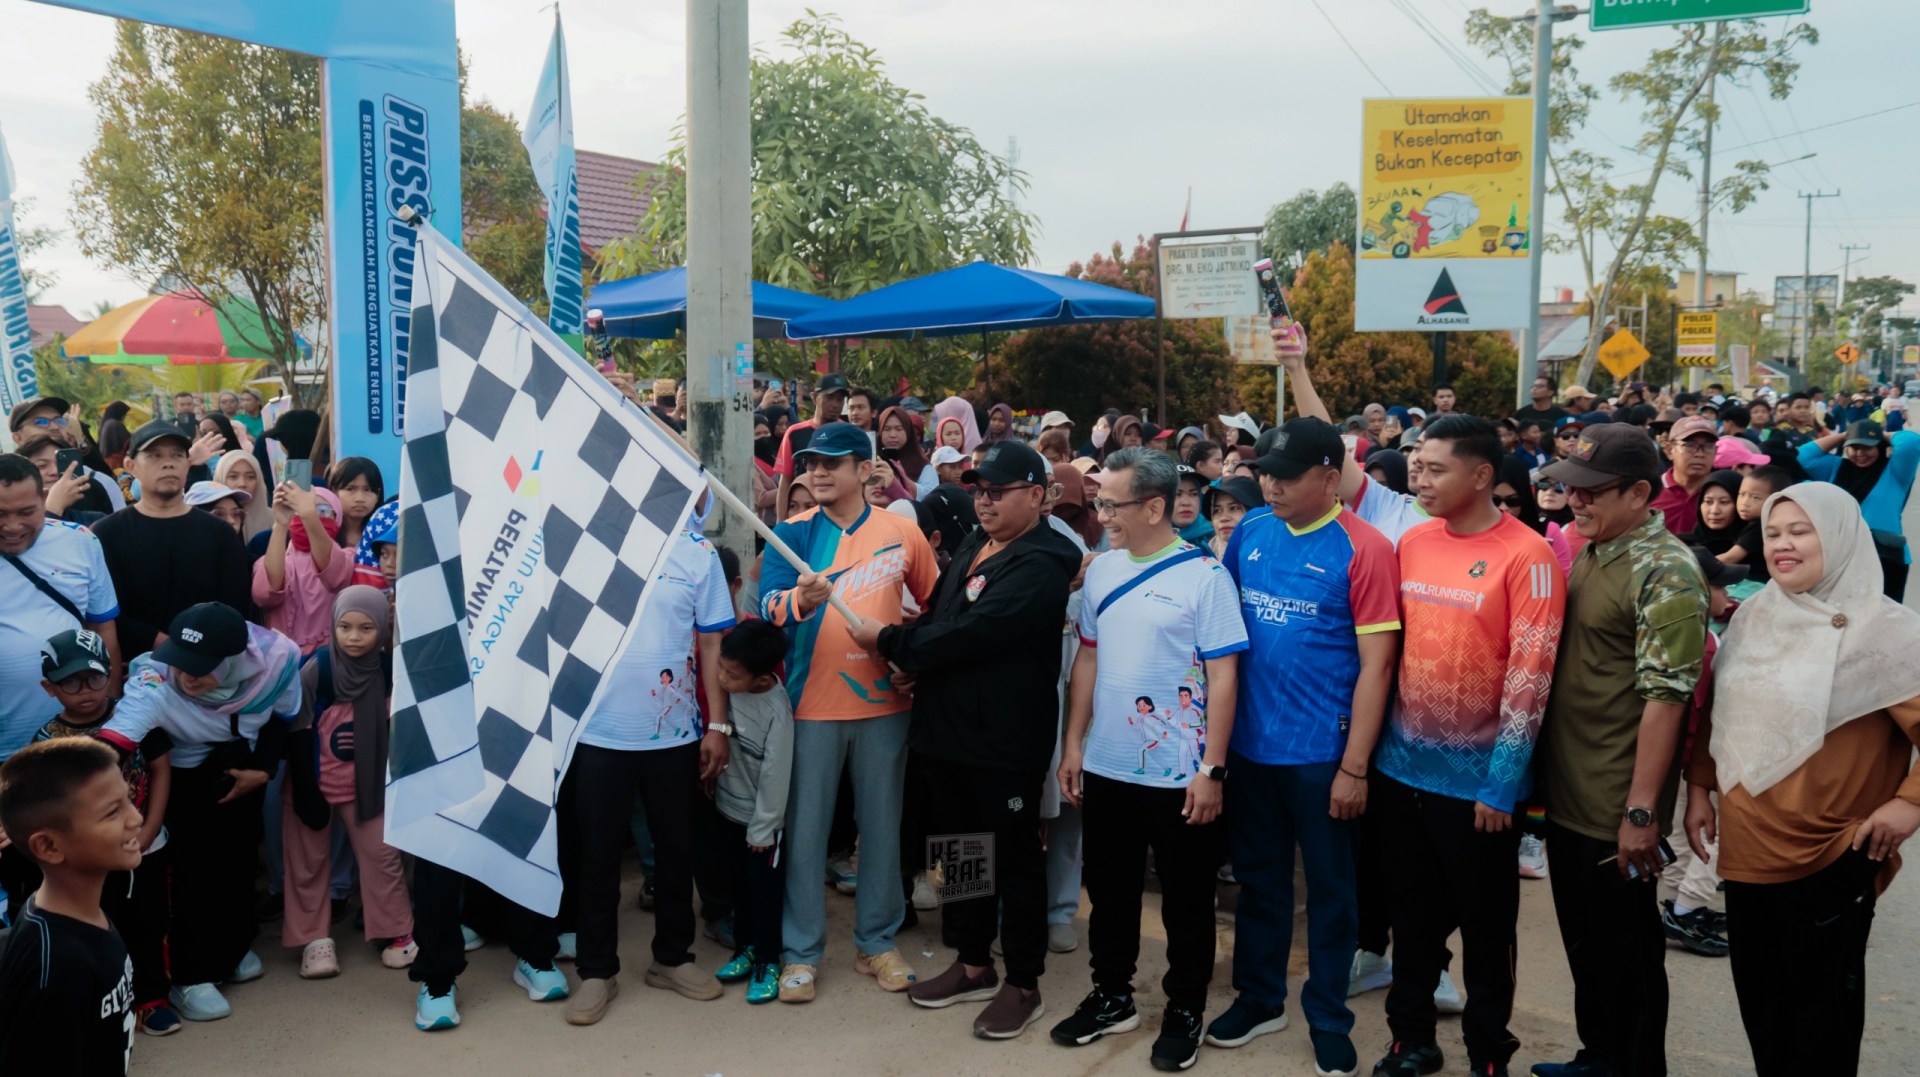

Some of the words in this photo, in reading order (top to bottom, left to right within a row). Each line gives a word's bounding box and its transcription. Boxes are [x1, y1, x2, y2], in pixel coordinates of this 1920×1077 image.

[1393, 128, 1503, 148] Keselamatan
[1404, 105, 1491, 126] Utamakan
[362, 114, 373, 175] BERSATU
[388, 98, 430, 220] PHSS
[1375, 152, 1425, 172] Bukan
[1431, 147, 1523, 168] Kecepatan
[364, 178, 375, 266] MELANGKAH
[556, 173, 582, 280] WA
[1216, 260, 1250, 272] JATMIKO
[367, 270, 379, 367] MENGUATKAN
[370, 372, 381, 419] ENERGI
[836, 549, 906, 599] PHSS
[1241, 586, 1318, 616] ENERGIZING
